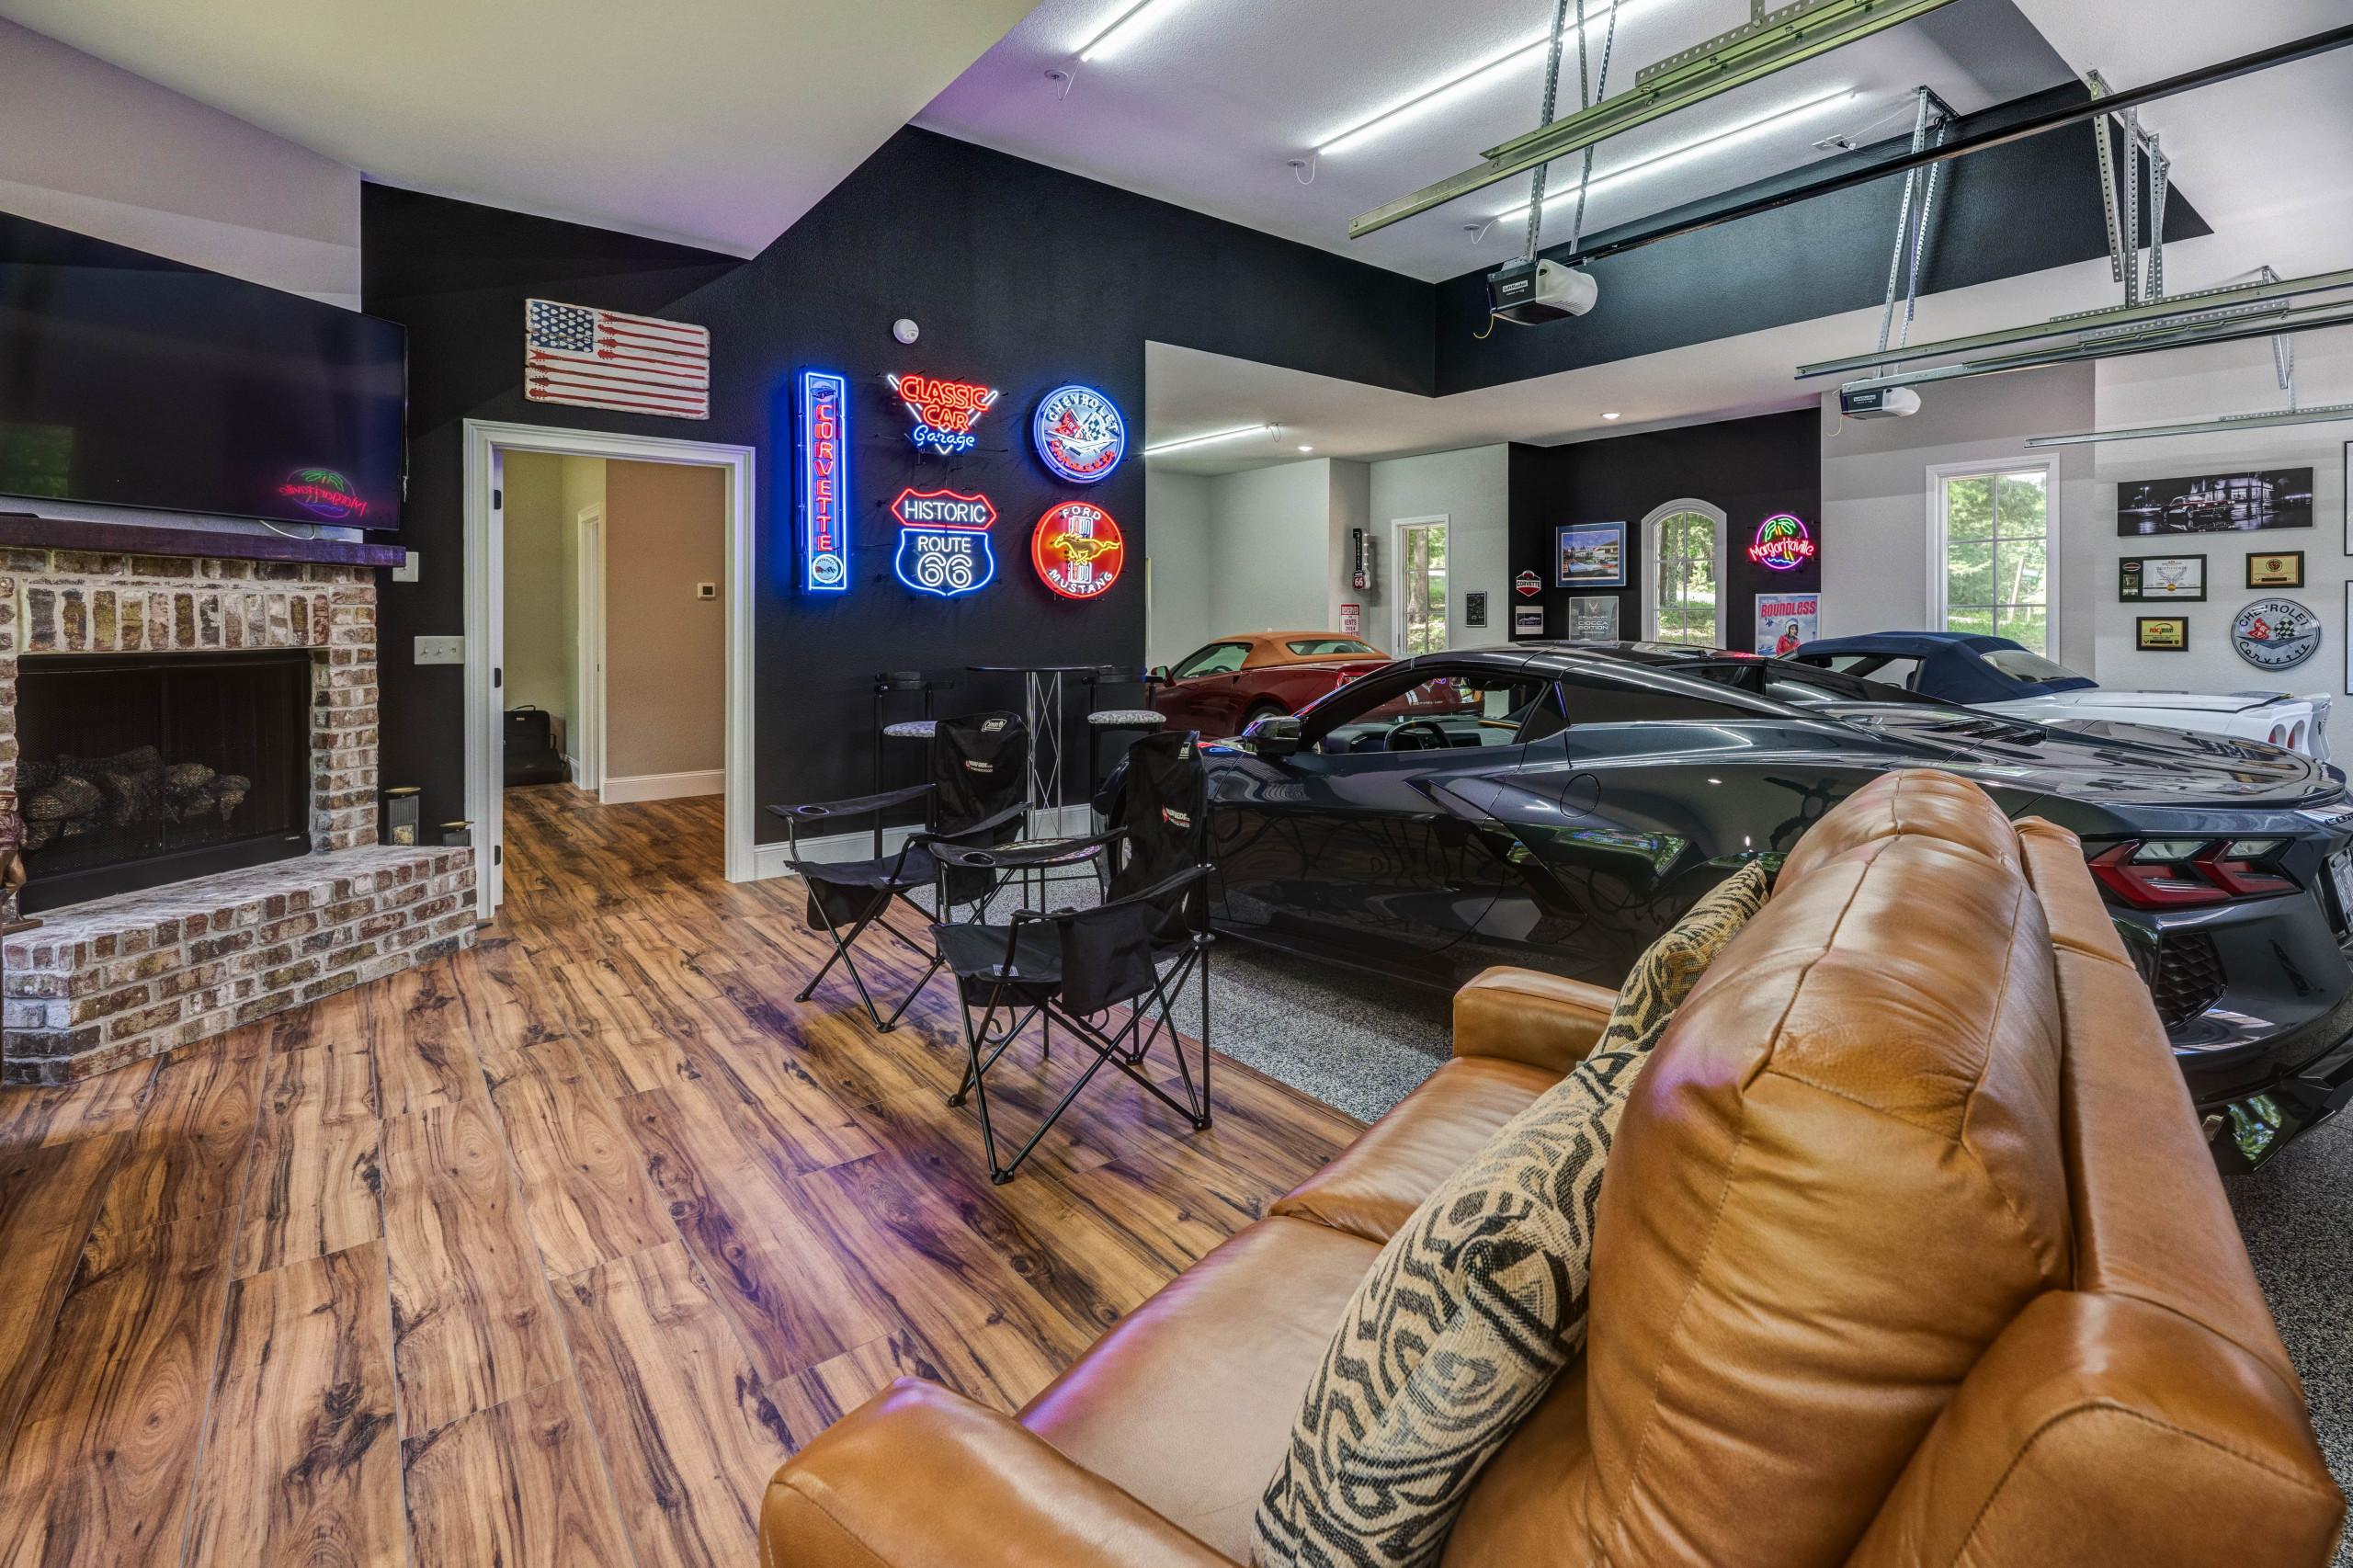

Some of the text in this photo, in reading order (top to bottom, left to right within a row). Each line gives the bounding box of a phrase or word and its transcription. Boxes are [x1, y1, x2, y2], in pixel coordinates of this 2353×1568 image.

[899, 375, 989, 412] CLASSIC
[922, 404, 969, 432] CAR
[1047, 392, 1120, 437] CHEVROLET
[913, 424, 976, 451] Garage
[813, 403, 834, 551] CORVETTE
[904, 499, 986, 523] HISTORIC
[1061, 506, 1102, 521] FORD
[917, 535, 972, 553] ROUTE
[1749, 537, 1814, 561] Margaritaville
[917, 551, 972, 589] 66
[1048, 569, 1113, 594] MUSTANG
[1354, 577, 1364, 586] 66
[1517, 580, 1540, 588] CORVETTE
